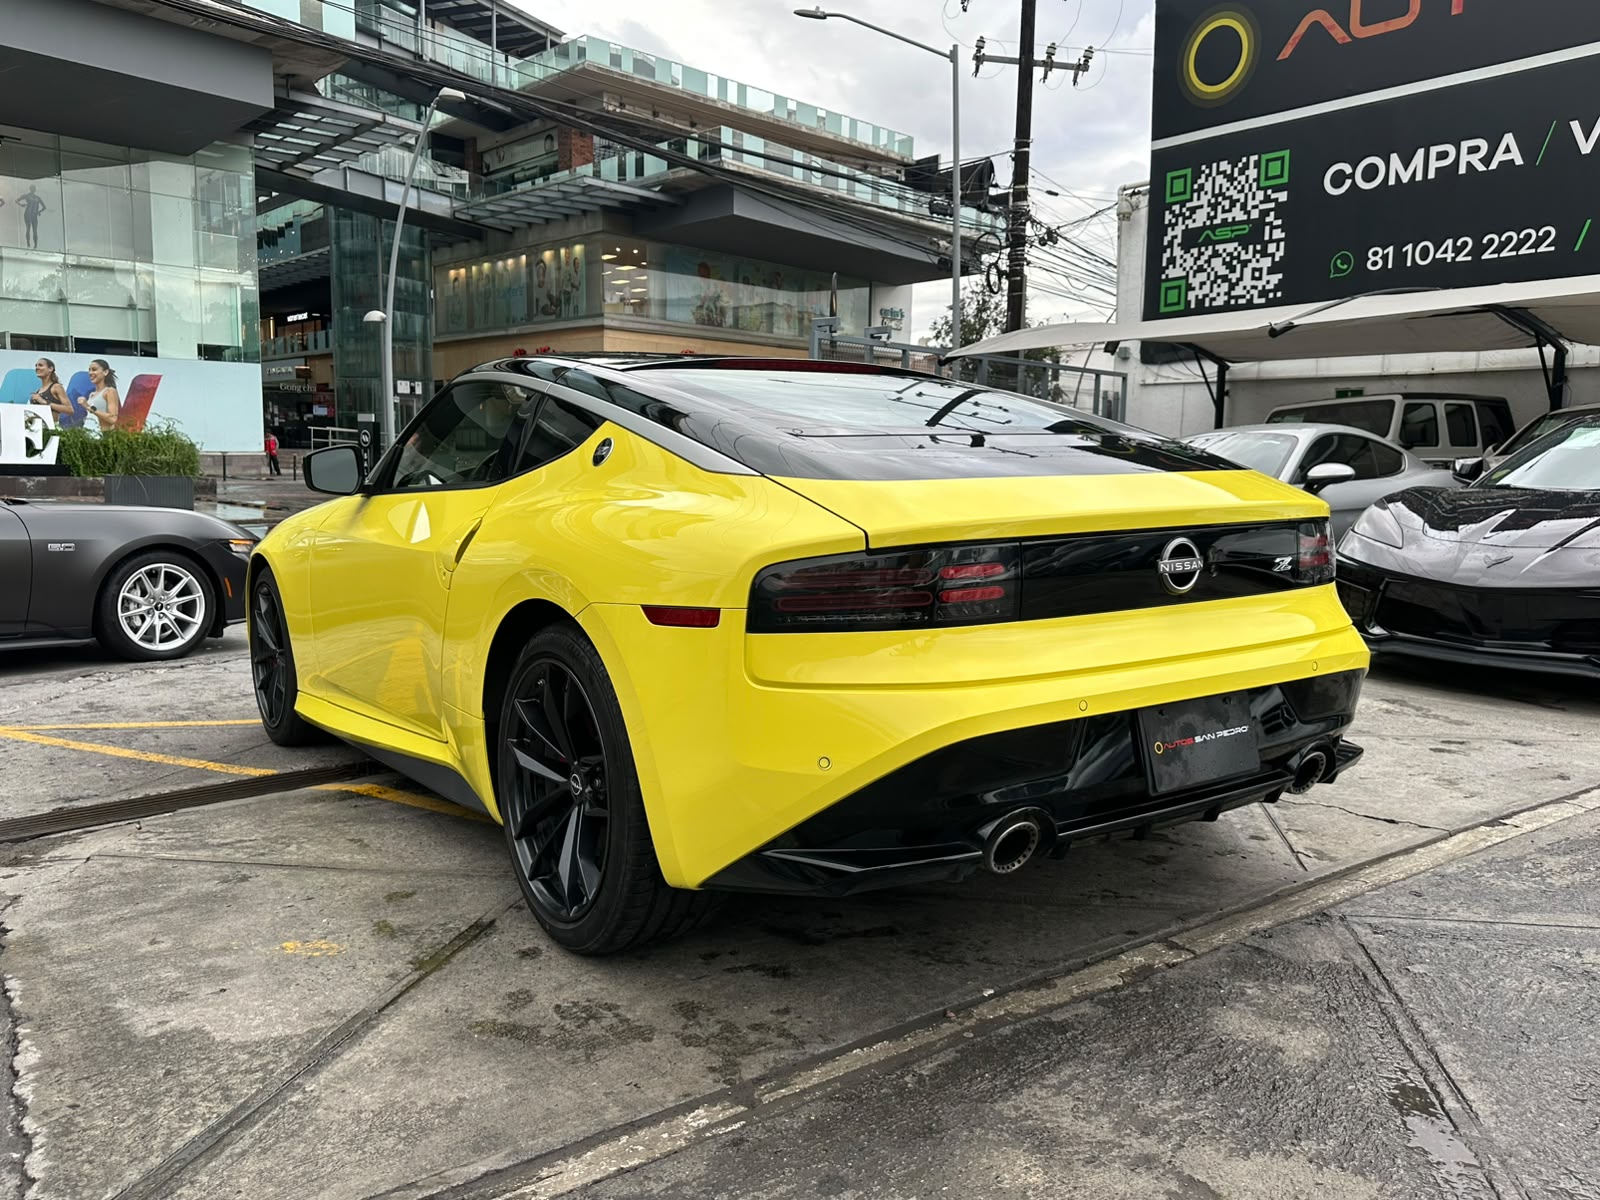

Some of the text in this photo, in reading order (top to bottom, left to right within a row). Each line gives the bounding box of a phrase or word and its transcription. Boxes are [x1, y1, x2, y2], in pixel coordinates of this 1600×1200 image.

[1323, 132, 1524, 196] COMPRA
[1366, 245, 1395, 271] 81
[1402, 235, 1474, 267] 1042
[1480, 225, 1557, 260] 2222
[280, 383, 317, 393] Gong cha
[1159, 559, 1204, 573] NISSAN
[1163, 725, 1248, 750] AUTOS SAN PEDRO
